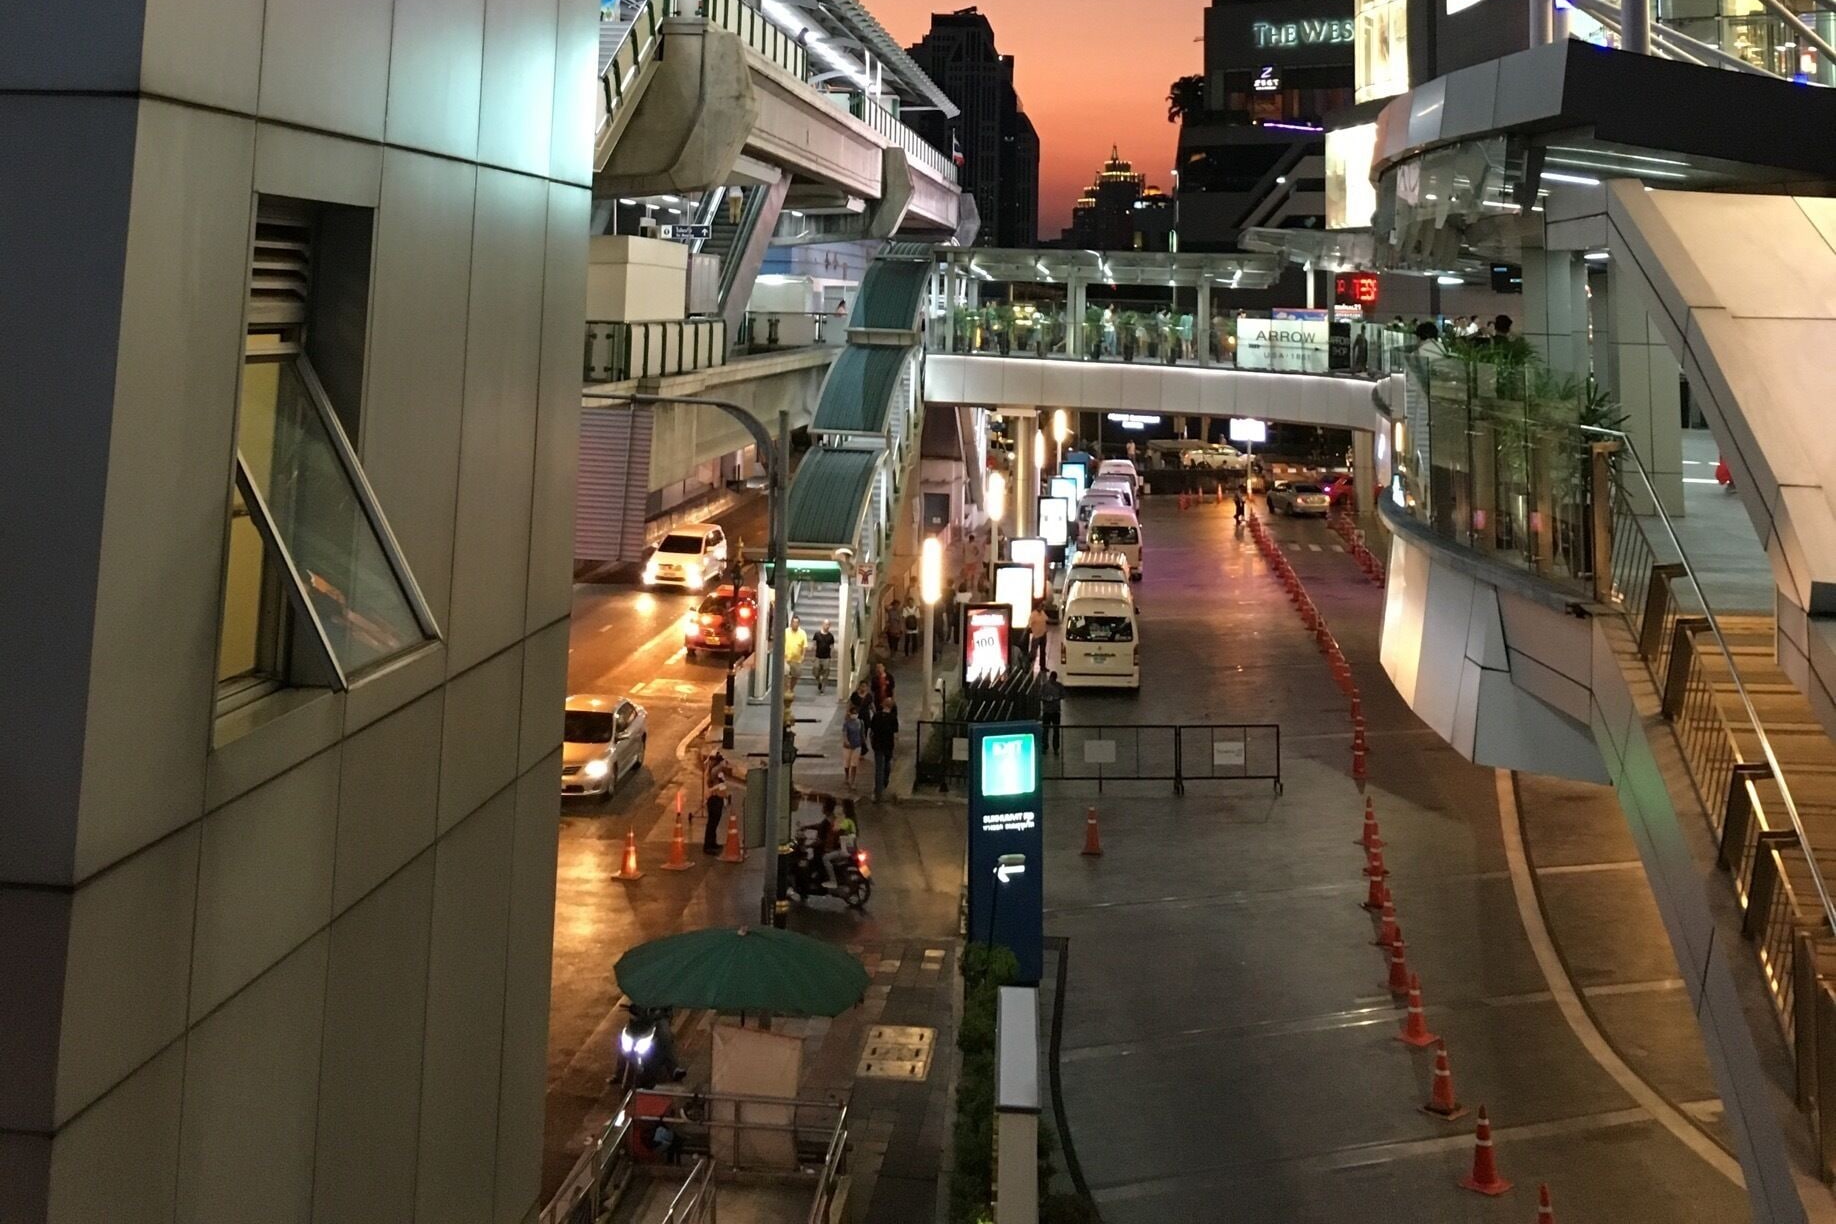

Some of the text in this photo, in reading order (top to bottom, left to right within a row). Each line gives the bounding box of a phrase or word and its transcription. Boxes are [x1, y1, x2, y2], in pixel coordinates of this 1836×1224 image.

[1253, 22, 1298, 48] THE
[1256, 330, 1315, 343] ARROW
[976, 636, 995, 648] 100
